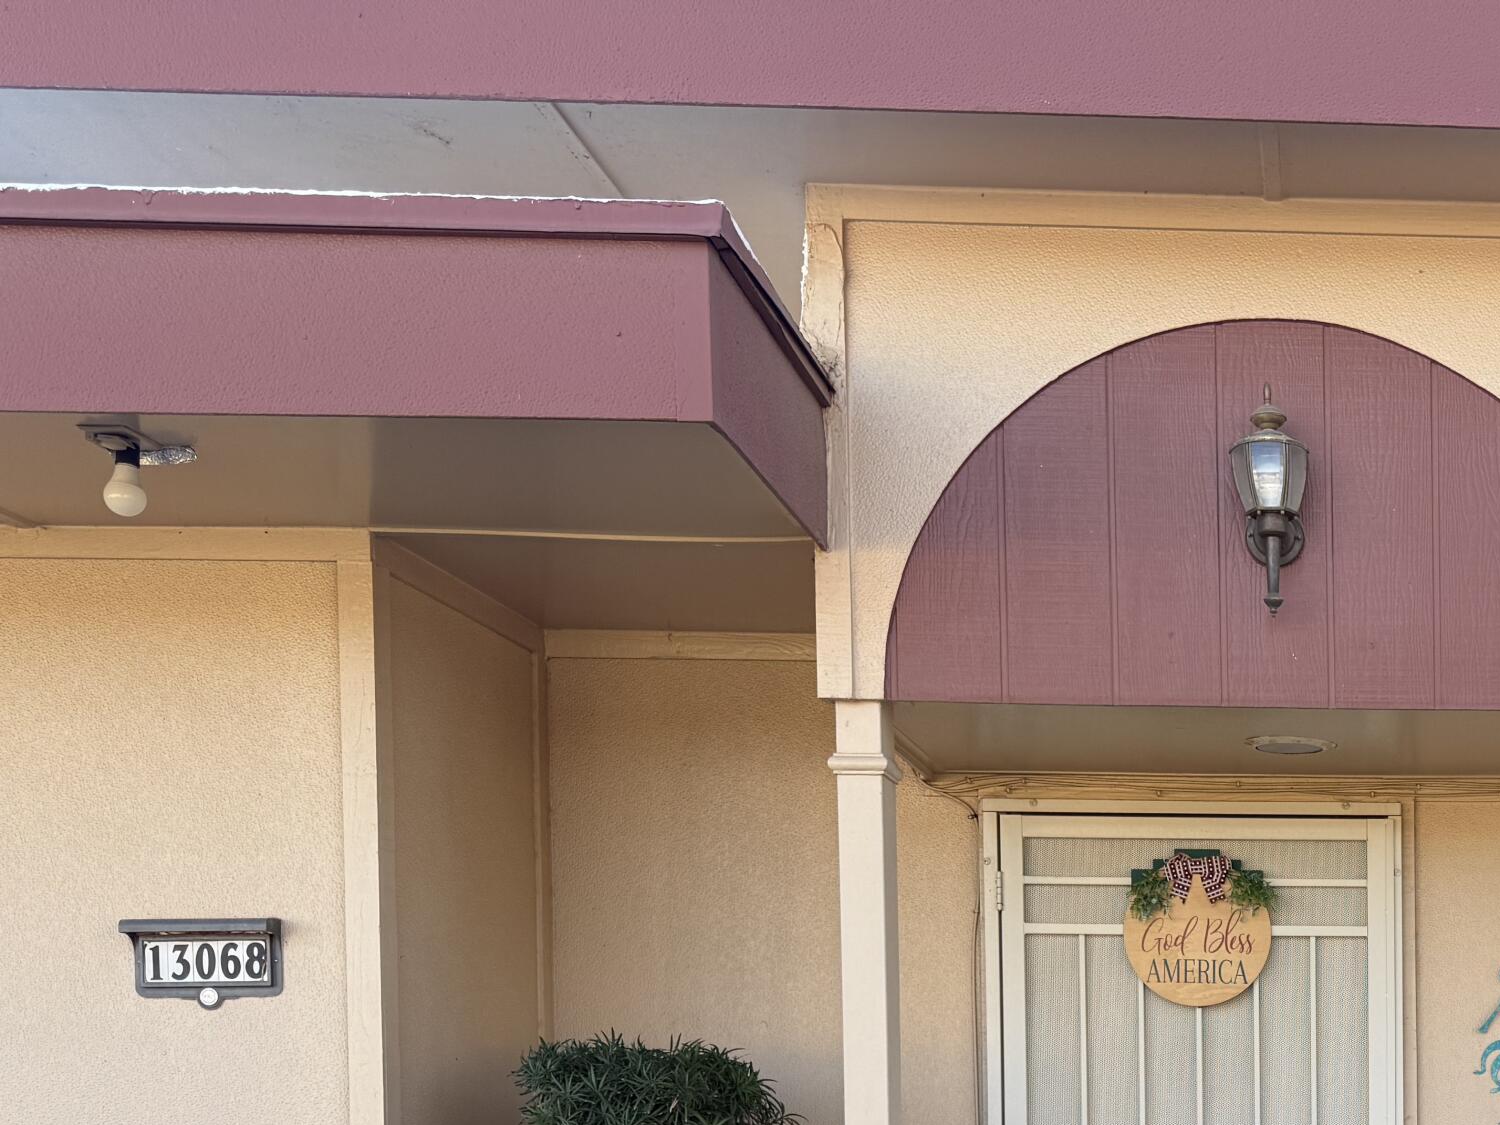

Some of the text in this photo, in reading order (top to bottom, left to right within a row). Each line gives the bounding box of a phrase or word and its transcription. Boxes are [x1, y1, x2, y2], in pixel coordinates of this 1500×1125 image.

[1142, 910, 1256, 955] God Bless
[148, 942, 267, 980] 13068
[1146, 958, 1248, 985] AMERICA
